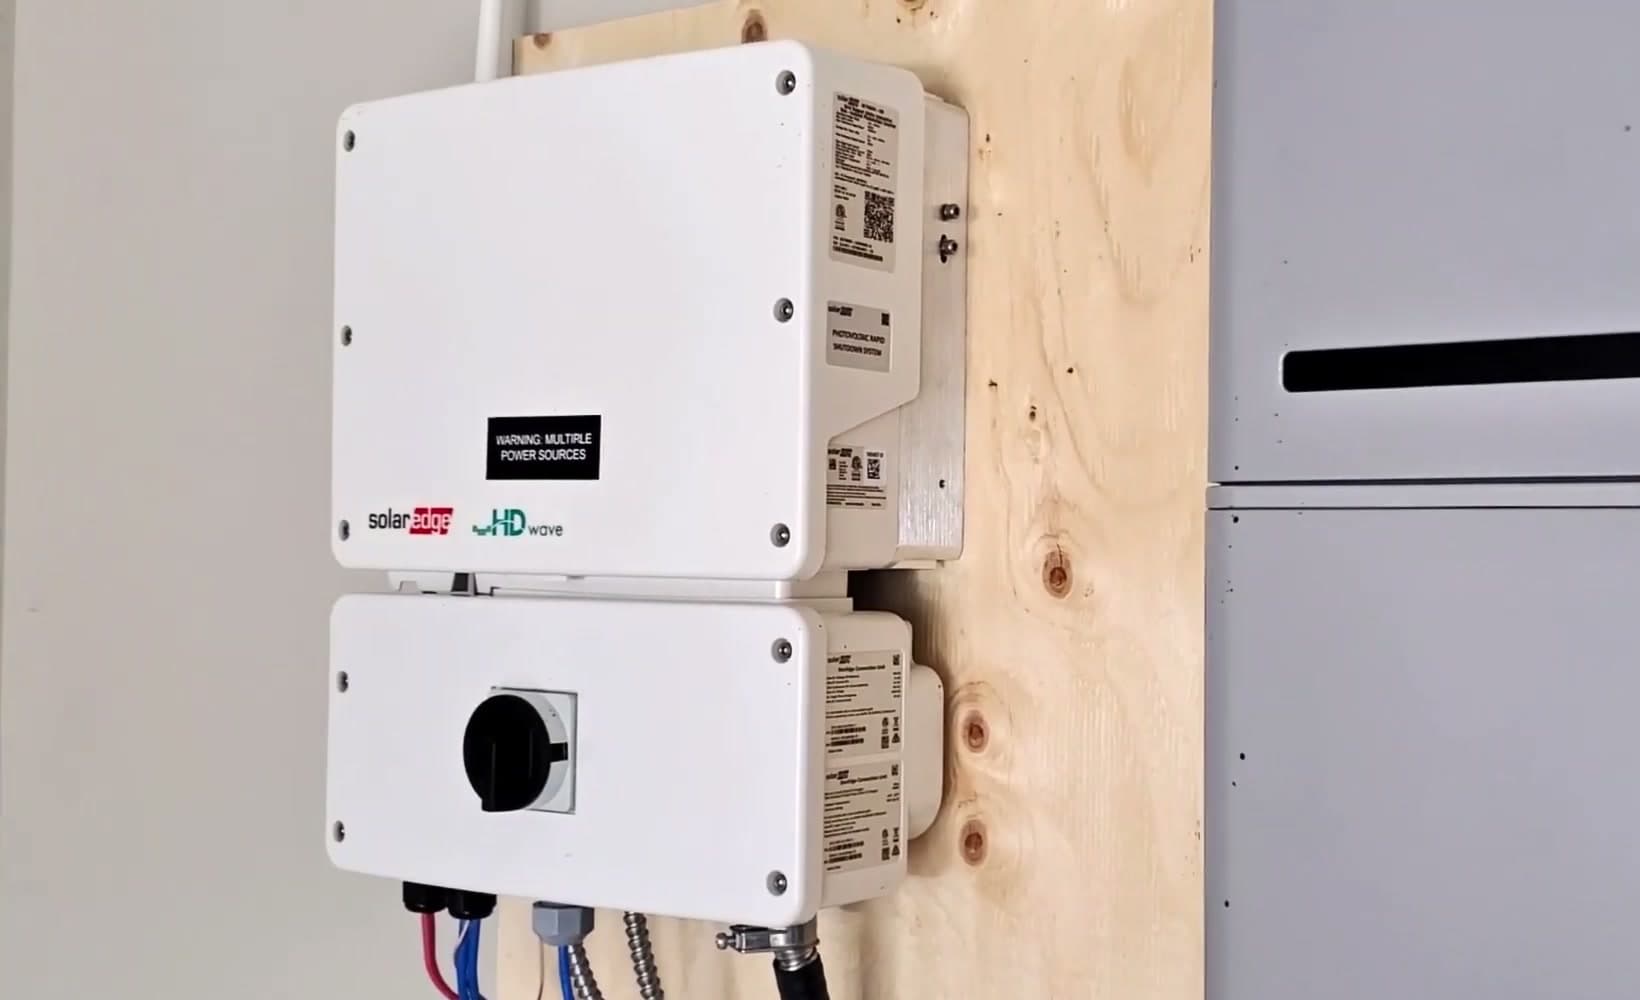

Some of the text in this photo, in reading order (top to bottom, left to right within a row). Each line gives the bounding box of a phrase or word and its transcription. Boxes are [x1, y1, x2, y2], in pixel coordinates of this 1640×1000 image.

[545, 432, 593, 445] MULTIPLE
[501, 448, 587, 461] POWER SOURCES
[528, 523, 563, 536] wave
